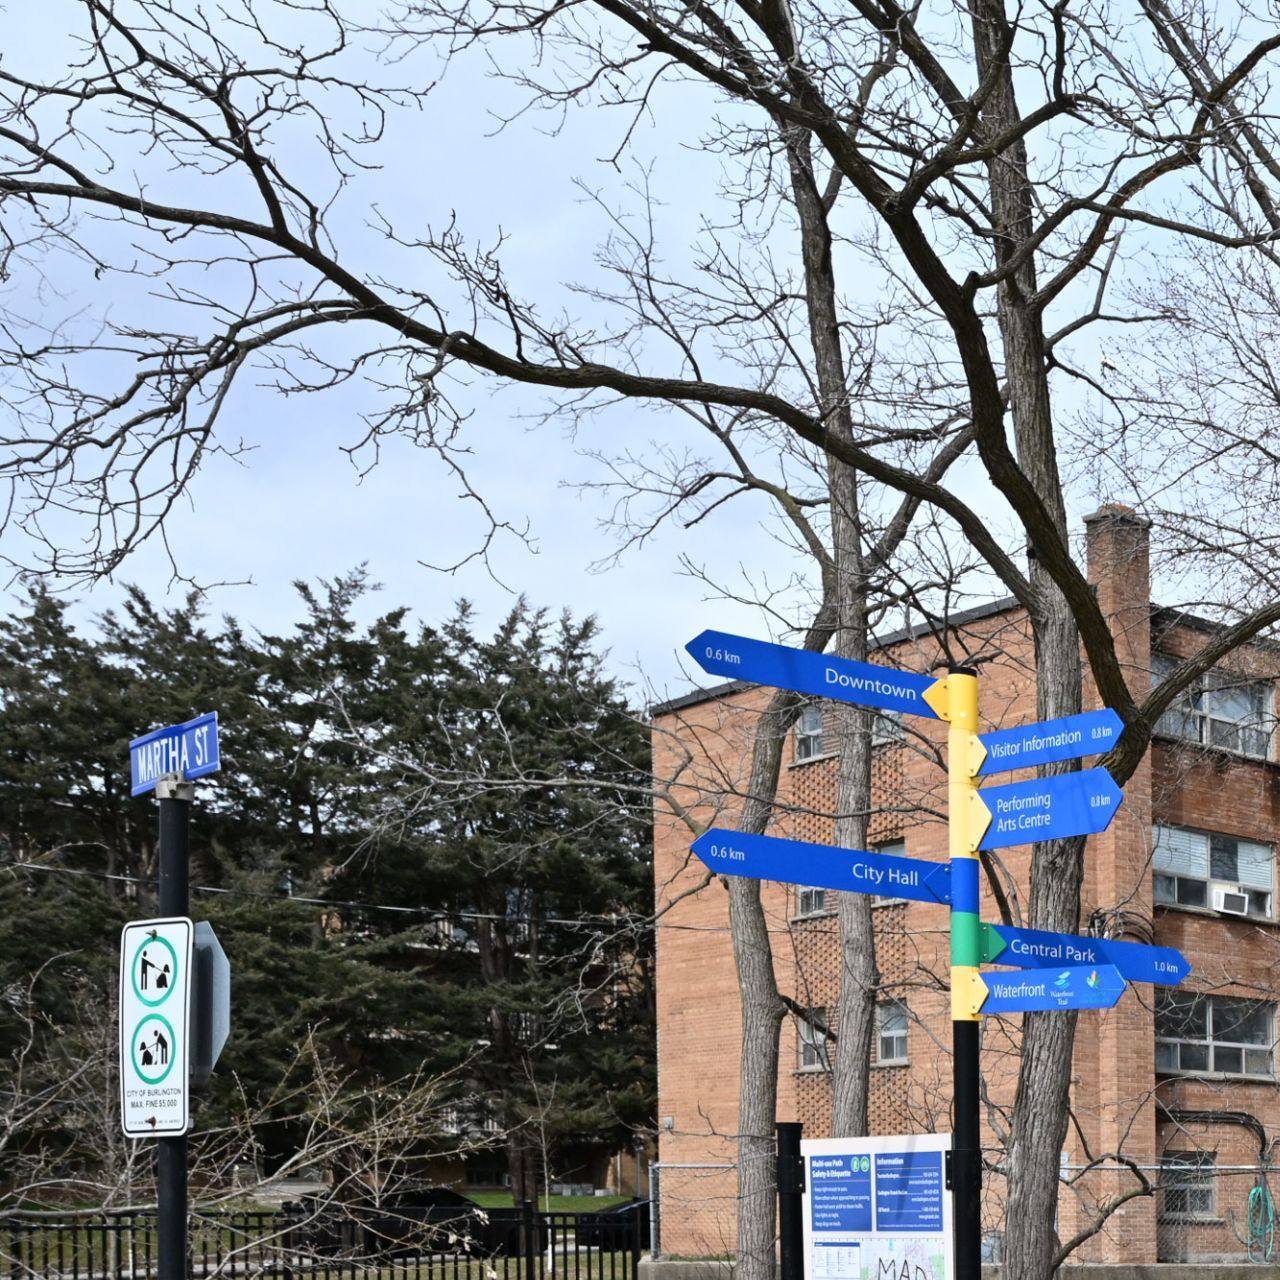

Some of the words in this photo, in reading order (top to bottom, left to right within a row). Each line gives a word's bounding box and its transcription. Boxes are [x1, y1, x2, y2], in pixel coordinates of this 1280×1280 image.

[705, 646, 721, 662] 0.6
[722, 648, 741, 665] km
[824, 667, 917, 702] Downtown
[990, 740, 1022, 759] Visitor
[1023, 728, 1082, 755] Information
[1091, 726, 1102, 740] 0.8
[1103, 724, 1113, 738] km
[138, 734, 189, 783] MARTHA
[194, 726, 209, 765] ST
[996, 791, 1051, 814] Performing
[1090, 794, 1101, 808] 0.8
[1101, 792, 1111, 807] km
[996, 814, 1016, 832] Arts
[1017, 811, 1051, 829] Centre
[710, 846, 726, 861] 0.6
[727, 847, 745, 863] km
[852, 863, 883, 884] City
[888, 866, 919, 887] Hall
[1010, 939, 1061, 963] Central
[1065, 946, 1096, 964] Park
[1153, 961, 1165, 973] 1.0
[1165, 962, 1178, 975] km
[993, 982, 1046, 999] Waterfront
[126, 1090, 138, 1098] CITY
[139, 1089, 146, 1097] OF
[147, 1087, 182, 1097] BURLINGTON
[145, 1100, 158, 1108] FINE
[832, 1159, 843, 1167] Path
[812, 1170, 827, 1179] Safety
